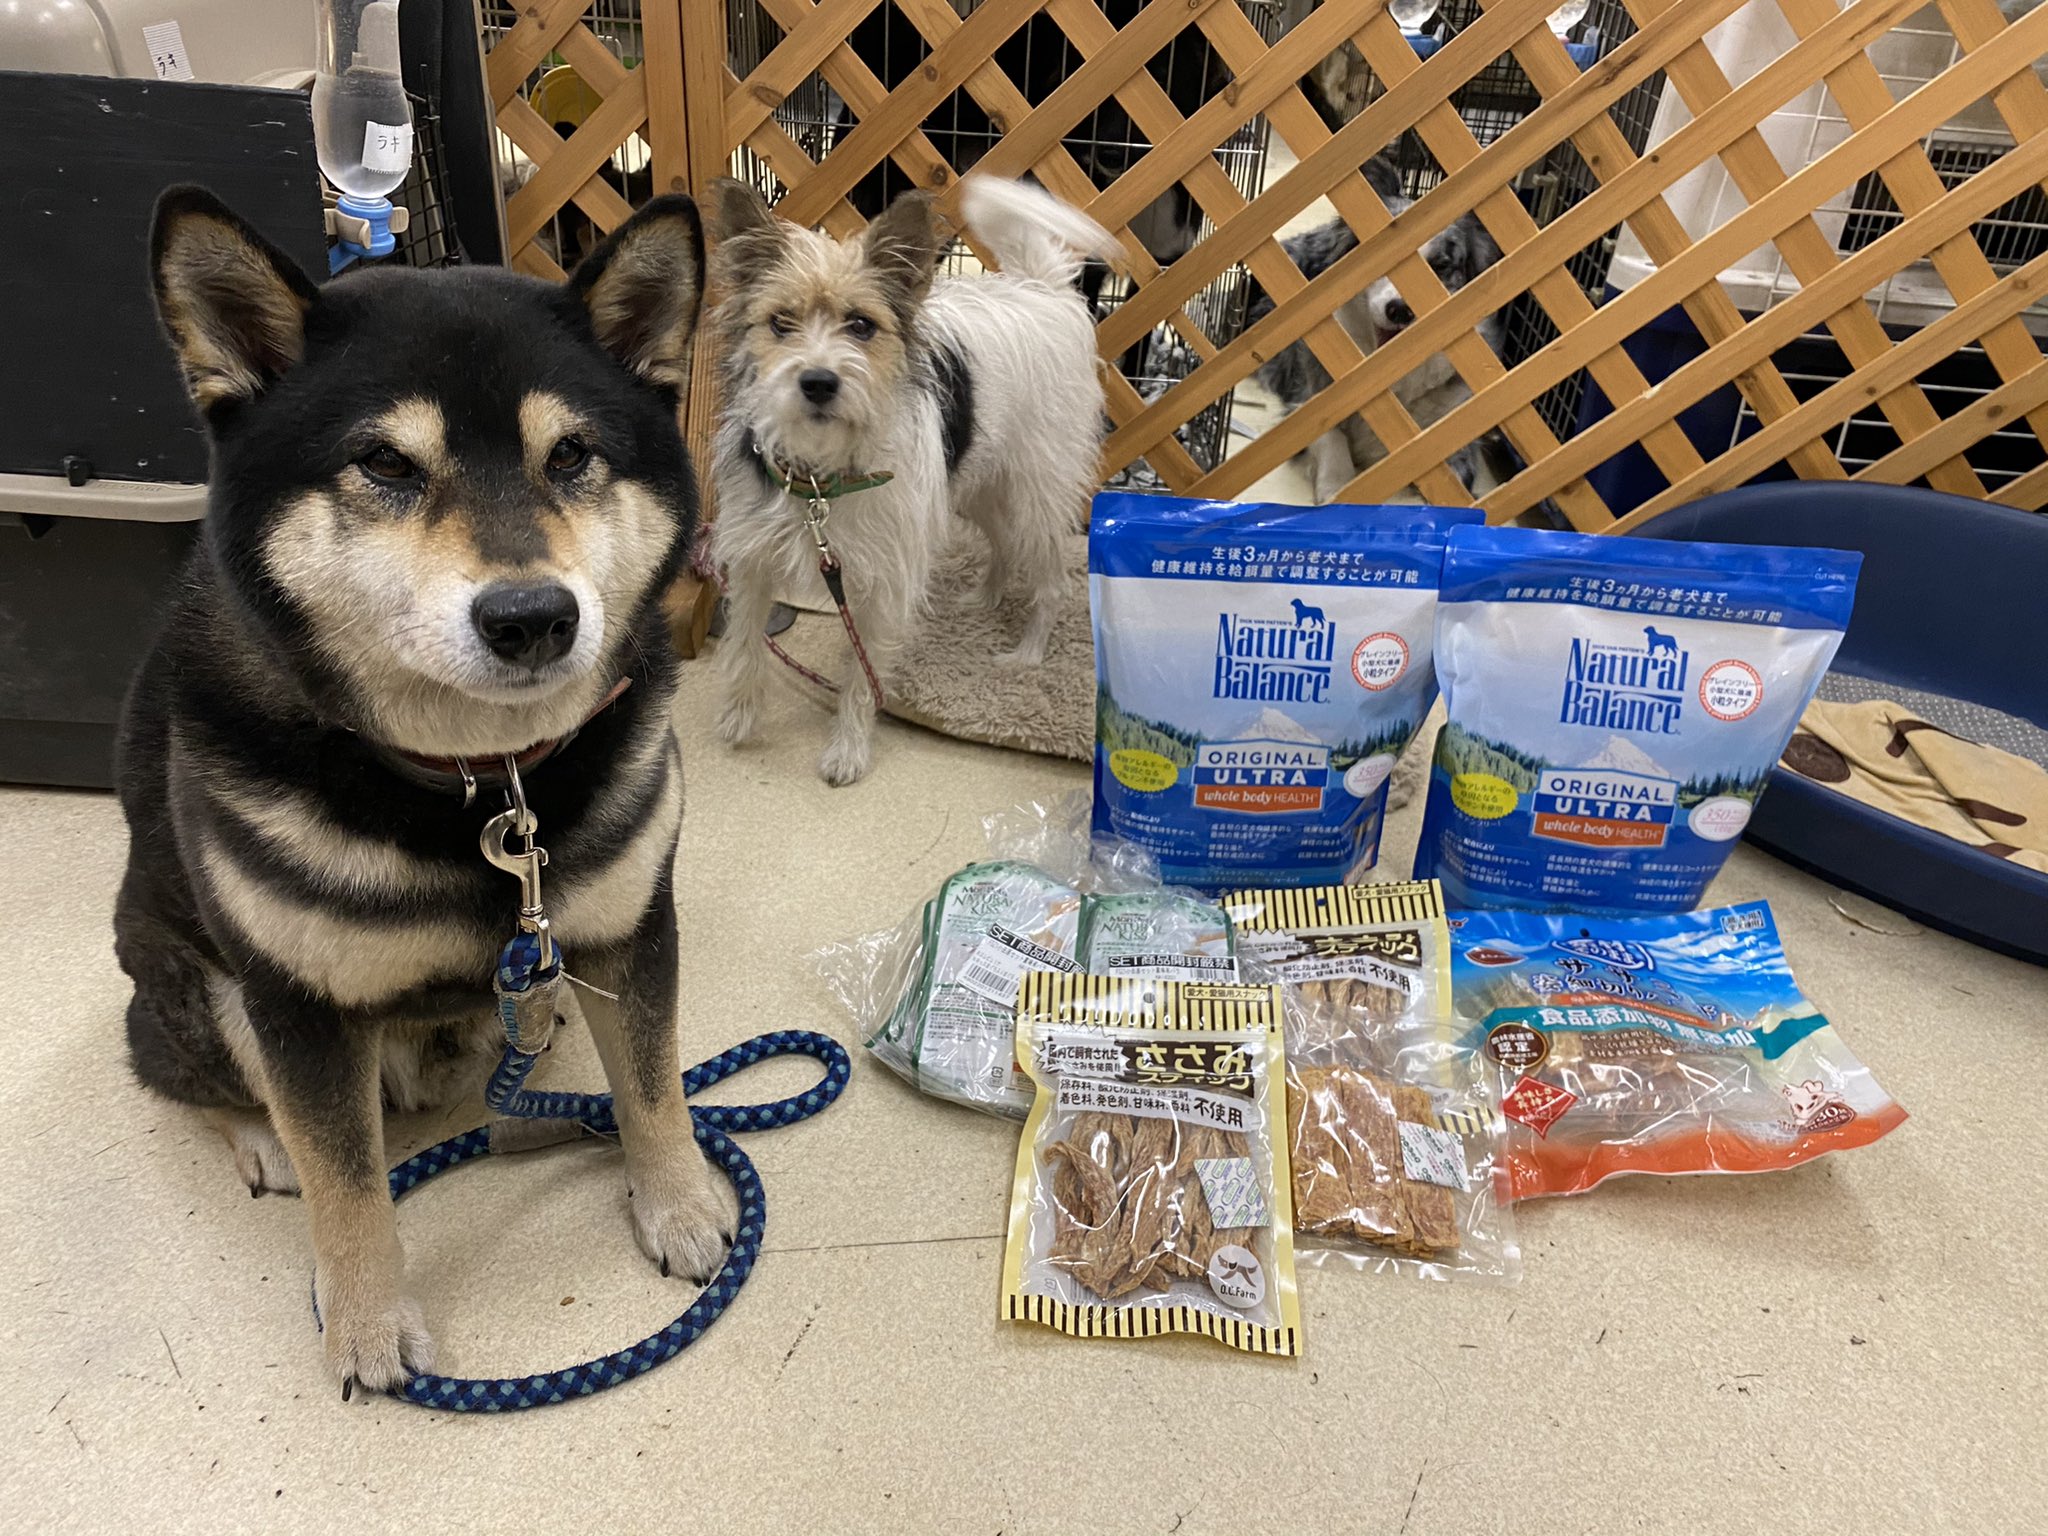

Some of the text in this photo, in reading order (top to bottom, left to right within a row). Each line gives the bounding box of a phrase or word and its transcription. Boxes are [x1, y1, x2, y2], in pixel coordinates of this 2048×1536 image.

[378, 136, 399, 153] ラキ
[1217, 613, 1336, 661] Natural
[1567, 638, 1689, 691] Natural
[1213, 656, 1331, 704] Balance
[1560, 680, 1682, 735] Balance
[1208, 751, 1318, 765] ORIGINAL
[1214, 769, 1307, 785] ULTRA
[1204, 790, 1314, 805] whole body HEALTH
[1551, 778, 1664, 802] ORIGINAL
[1555, 797, 1652, 821] ULTRA
[1544, 820, 1659, 839] whole body HEALTH
[1370, 964, 1411, 992] 不使用
[1135, 1043, 1247, 1076] ささみ
[1137, 1072, 1250, 1090] スティック
[1194, 1097, 1243, 1128] 不使用
